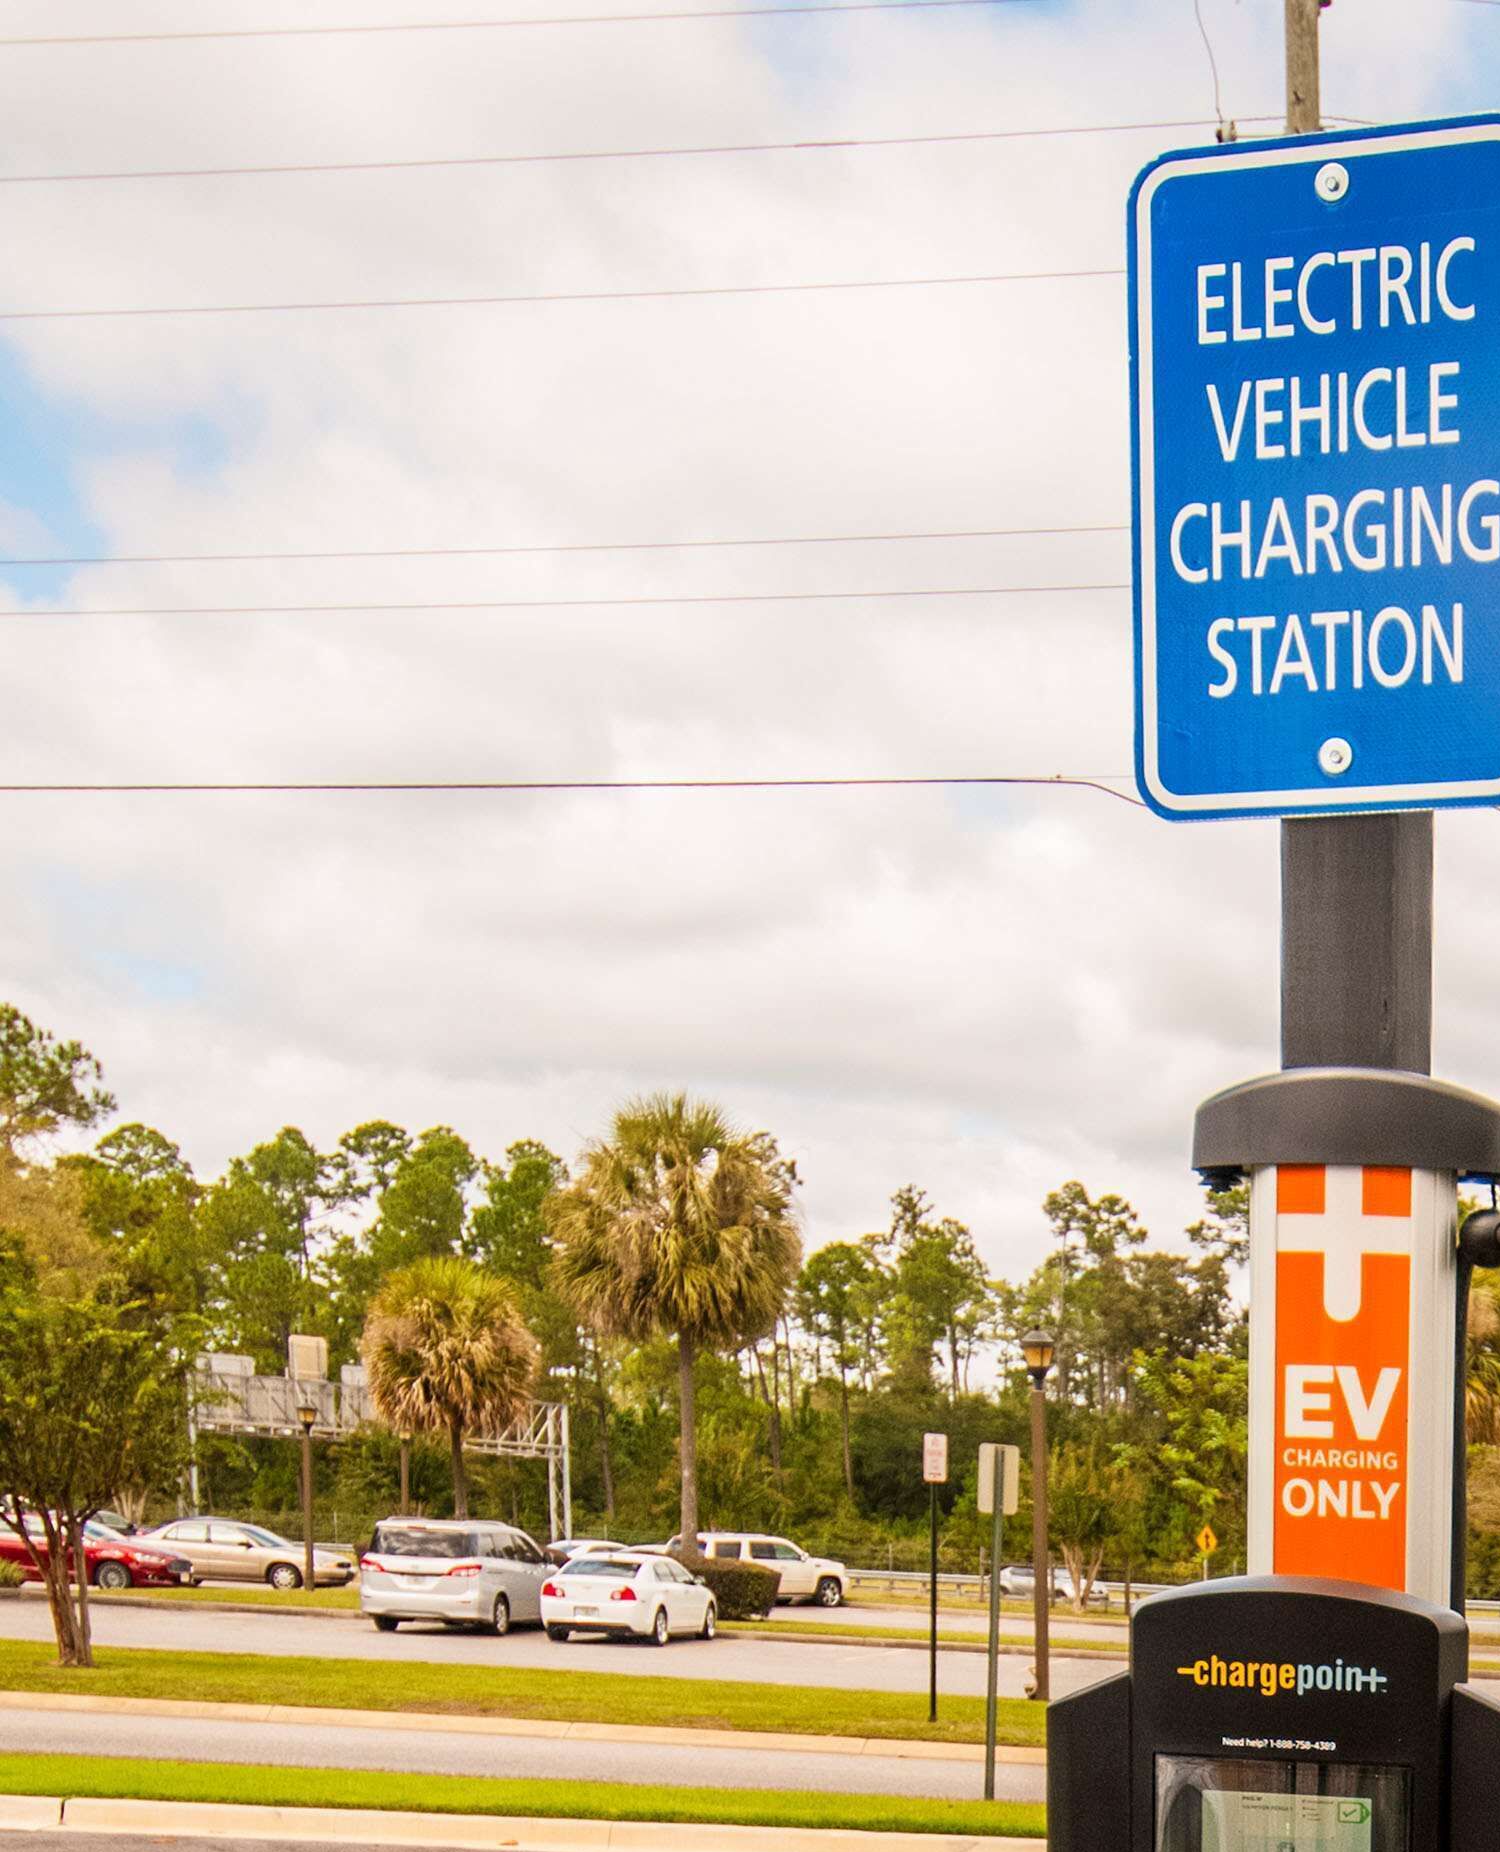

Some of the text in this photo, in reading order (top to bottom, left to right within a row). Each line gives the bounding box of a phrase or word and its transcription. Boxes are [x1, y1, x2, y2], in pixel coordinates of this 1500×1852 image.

[1196, 236, 1476, 345] ELECTRIC
[1206, 361, 1461, 463] VEHICLE
[1207, 603, 1463, 699] STATION
[1284, 1364, 1402, 1441] EV
[1283, 1447, 1398, 1471] CHARGING
[1281, 1477, 1401, 1520] ONLY
[1221, 1736, 1244, 1747] Need
[1245, 1737, 1269, 1749] help?
